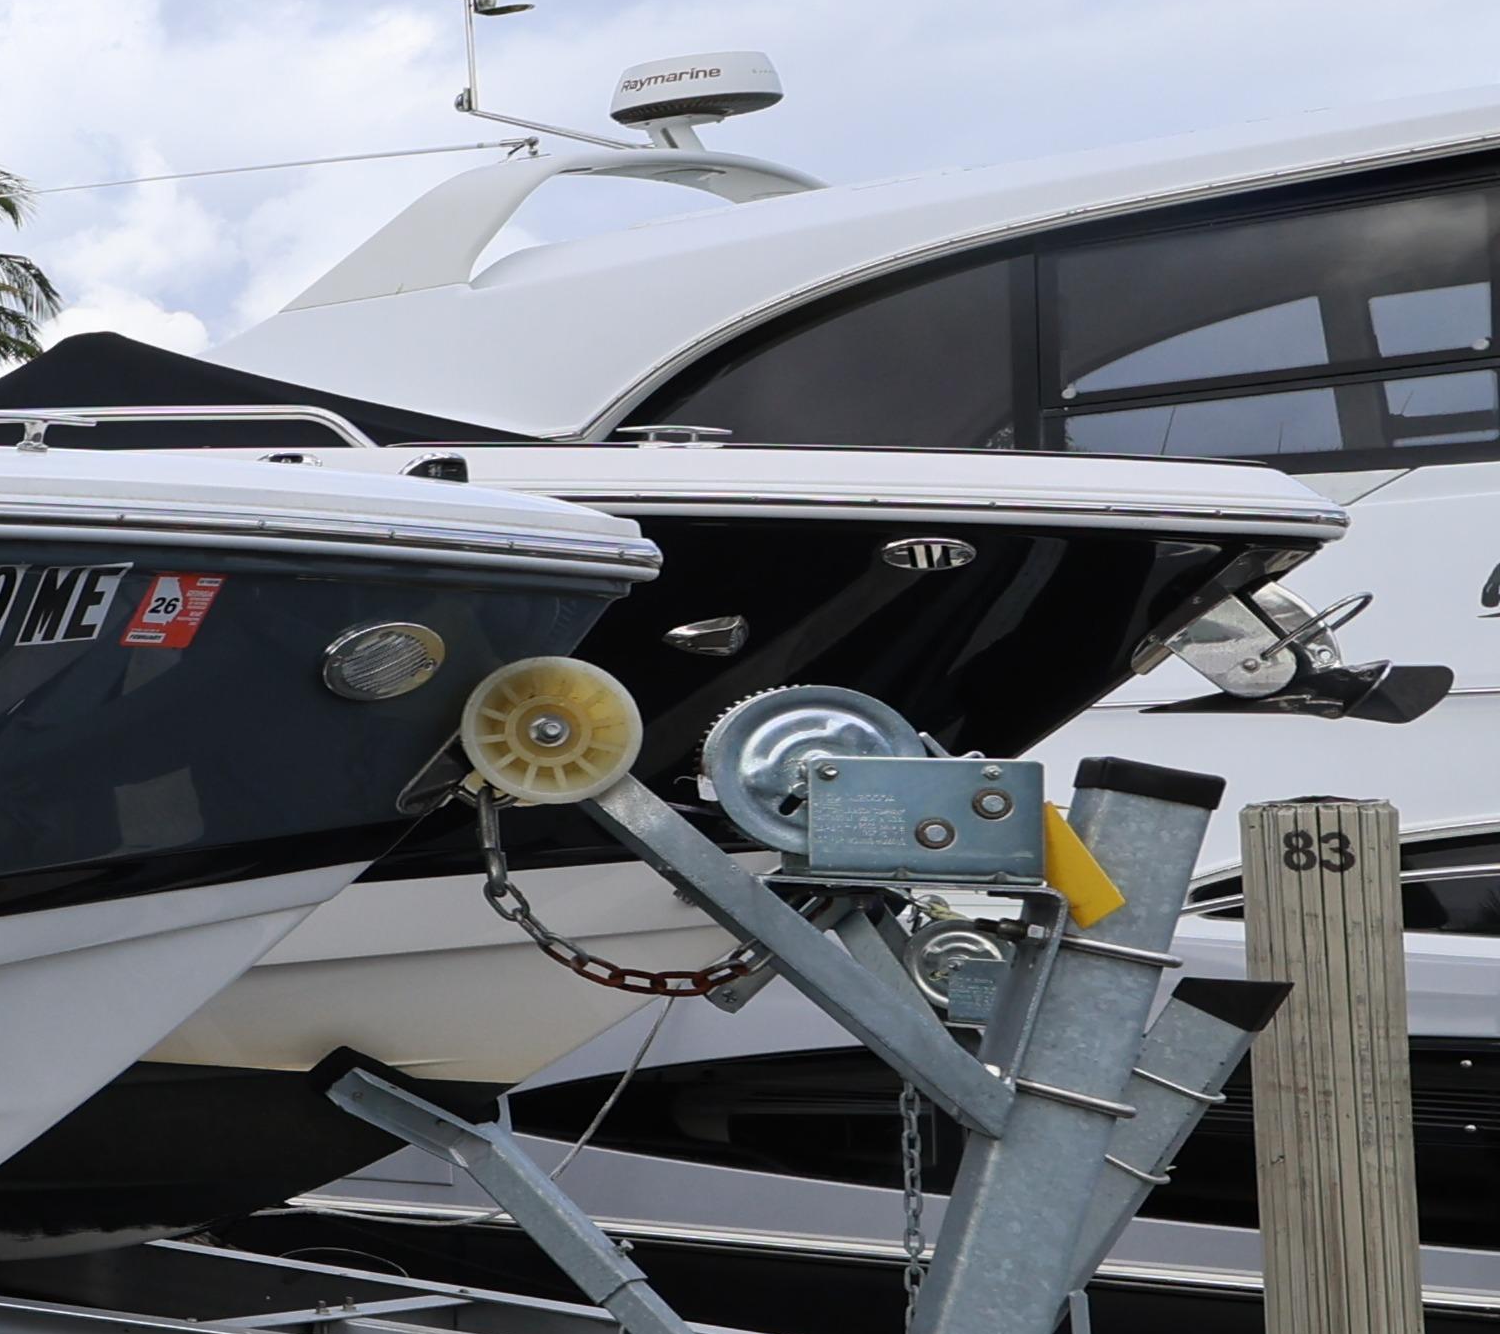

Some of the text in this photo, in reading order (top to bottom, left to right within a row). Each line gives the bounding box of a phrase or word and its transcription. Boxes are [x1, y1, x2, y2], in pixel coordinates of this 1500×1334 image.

[620, 67, 722, 92] Raymarine
[19, 565, 127, 643] ME
[148, 597, 179, 614] 26
[1283, 829, 1356, 872] 83
